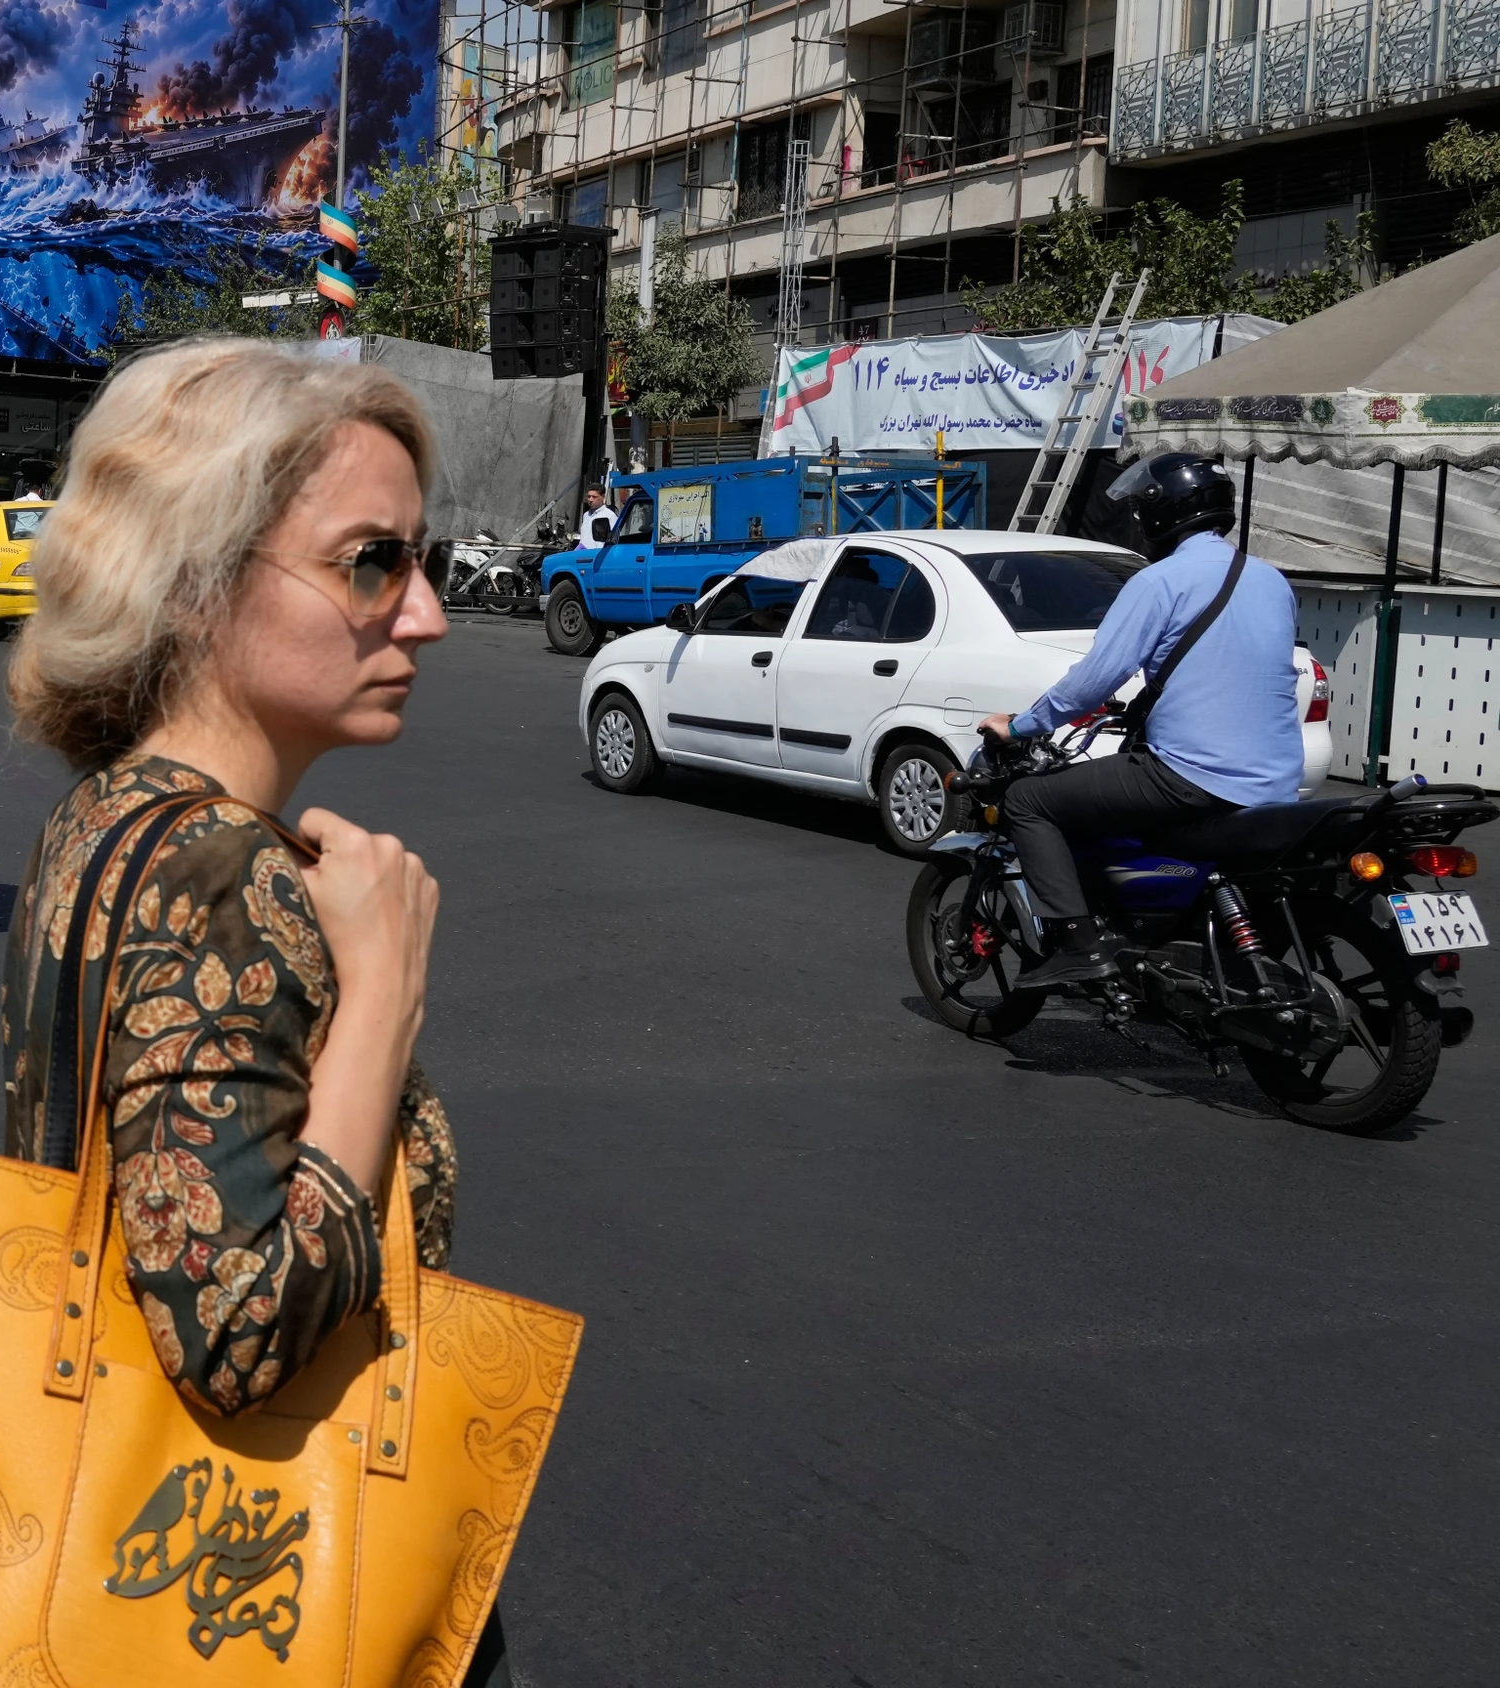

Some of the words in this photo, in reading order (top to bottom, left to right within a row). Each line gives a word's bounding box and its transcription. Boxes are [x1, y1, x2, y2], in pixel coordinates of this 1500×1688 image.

[575, 64, 614, 95] POLIC
[855, 357, 890, 391] ۱۱۴
[894, 367, 918, 392] سپاه
[964, 363, 1020, 385] اطلاعات
[1018, 362, 1060, 391] خبری
[1061, 360, 1093, 382] ساد
[919, 374, 928, 391] و
[930, 371, 961, 391] بسیج
[21, 421, 51, 433] ساعتی
[880, 415, 896, 432] بزرگ
[897, 414, 922, 431] تهران
[923, 414, 938, 428] الله
[939, 414, 964, 432] رسول
[966, 418, 991, 428] محمد
[994, 415, 1023, 432] حضرت
[1025, 415, 1042, 433] سپاه
[1422, 893, 1465, 918] ۱۵۹
[1411, 922, 1481, 949] ۱۴۱۶۱
